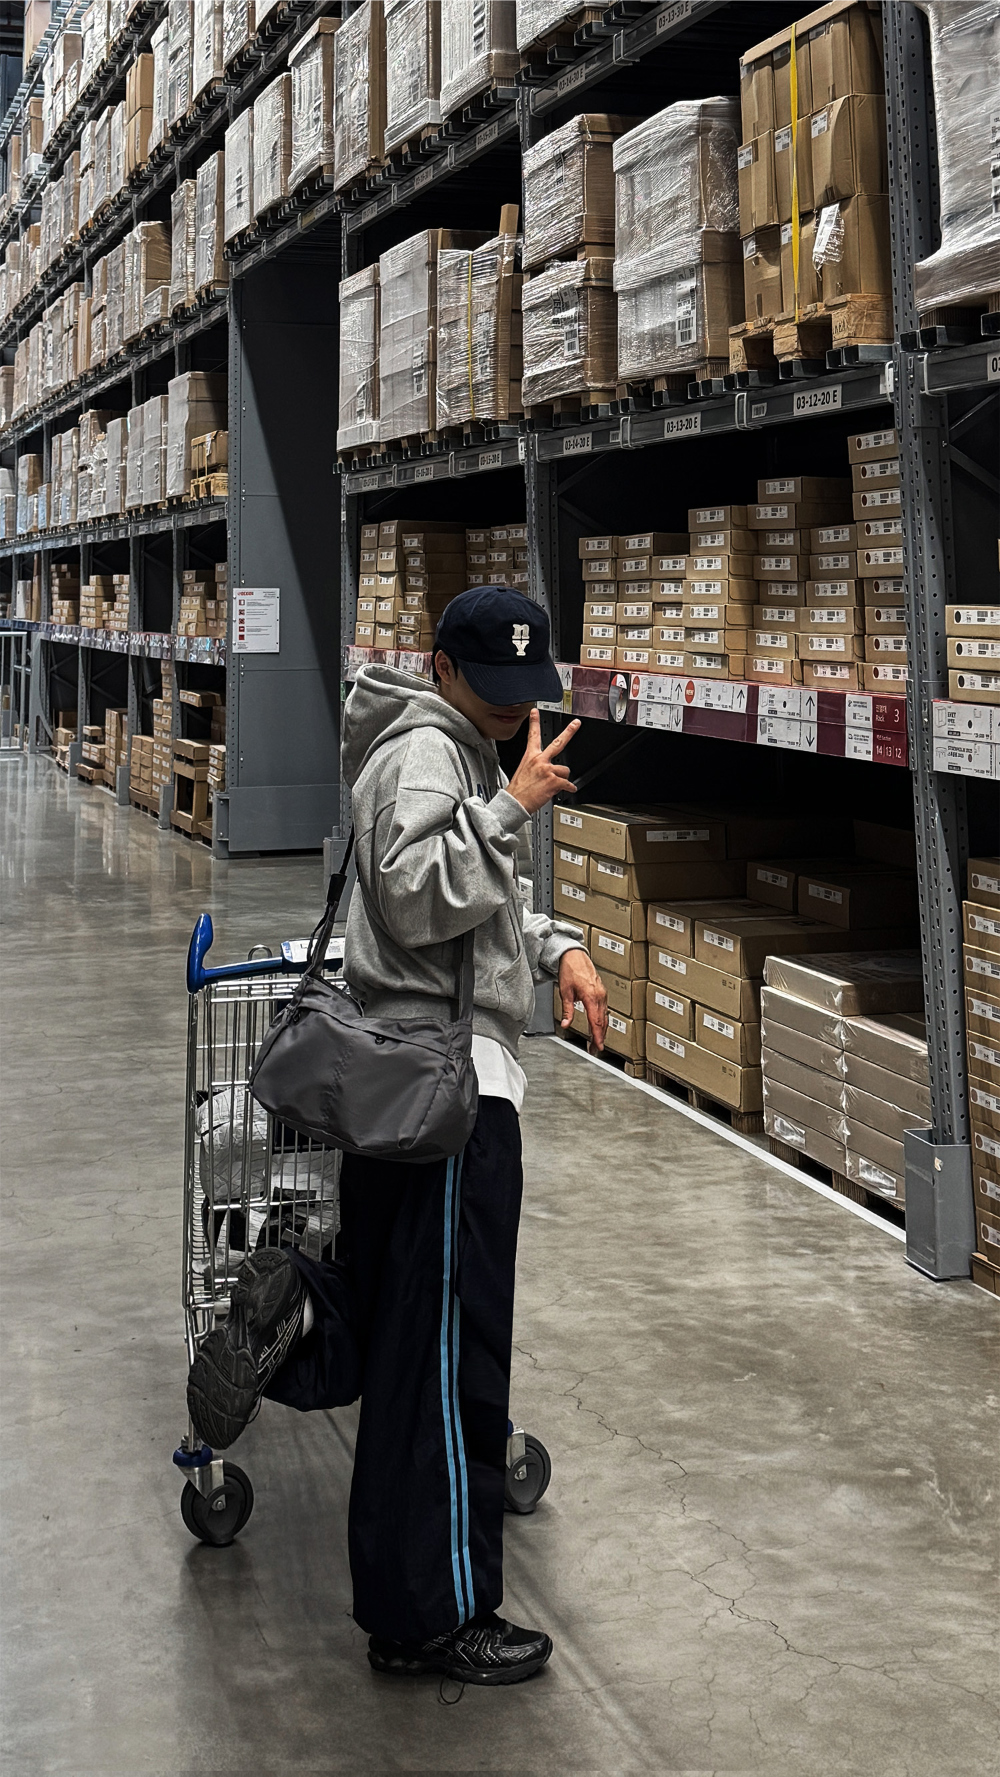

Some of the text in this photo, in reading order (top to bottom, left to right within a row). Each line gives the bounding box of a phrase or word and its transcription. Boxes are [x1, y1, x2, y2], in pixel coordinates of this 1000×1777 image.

[658, 1, 690, 29] 03-13-30 E
[558, 67, 584, 92] 03-14-30 E
[796, 389, 838, 410] 03-12-20 E
[666, 416, 698, 433] 03-13-20 E
[565, 436, 590, 451] 03-14-20 E
[893, 708, 900, 723] 3
[876, 745, 902, 759] 14 13 12
